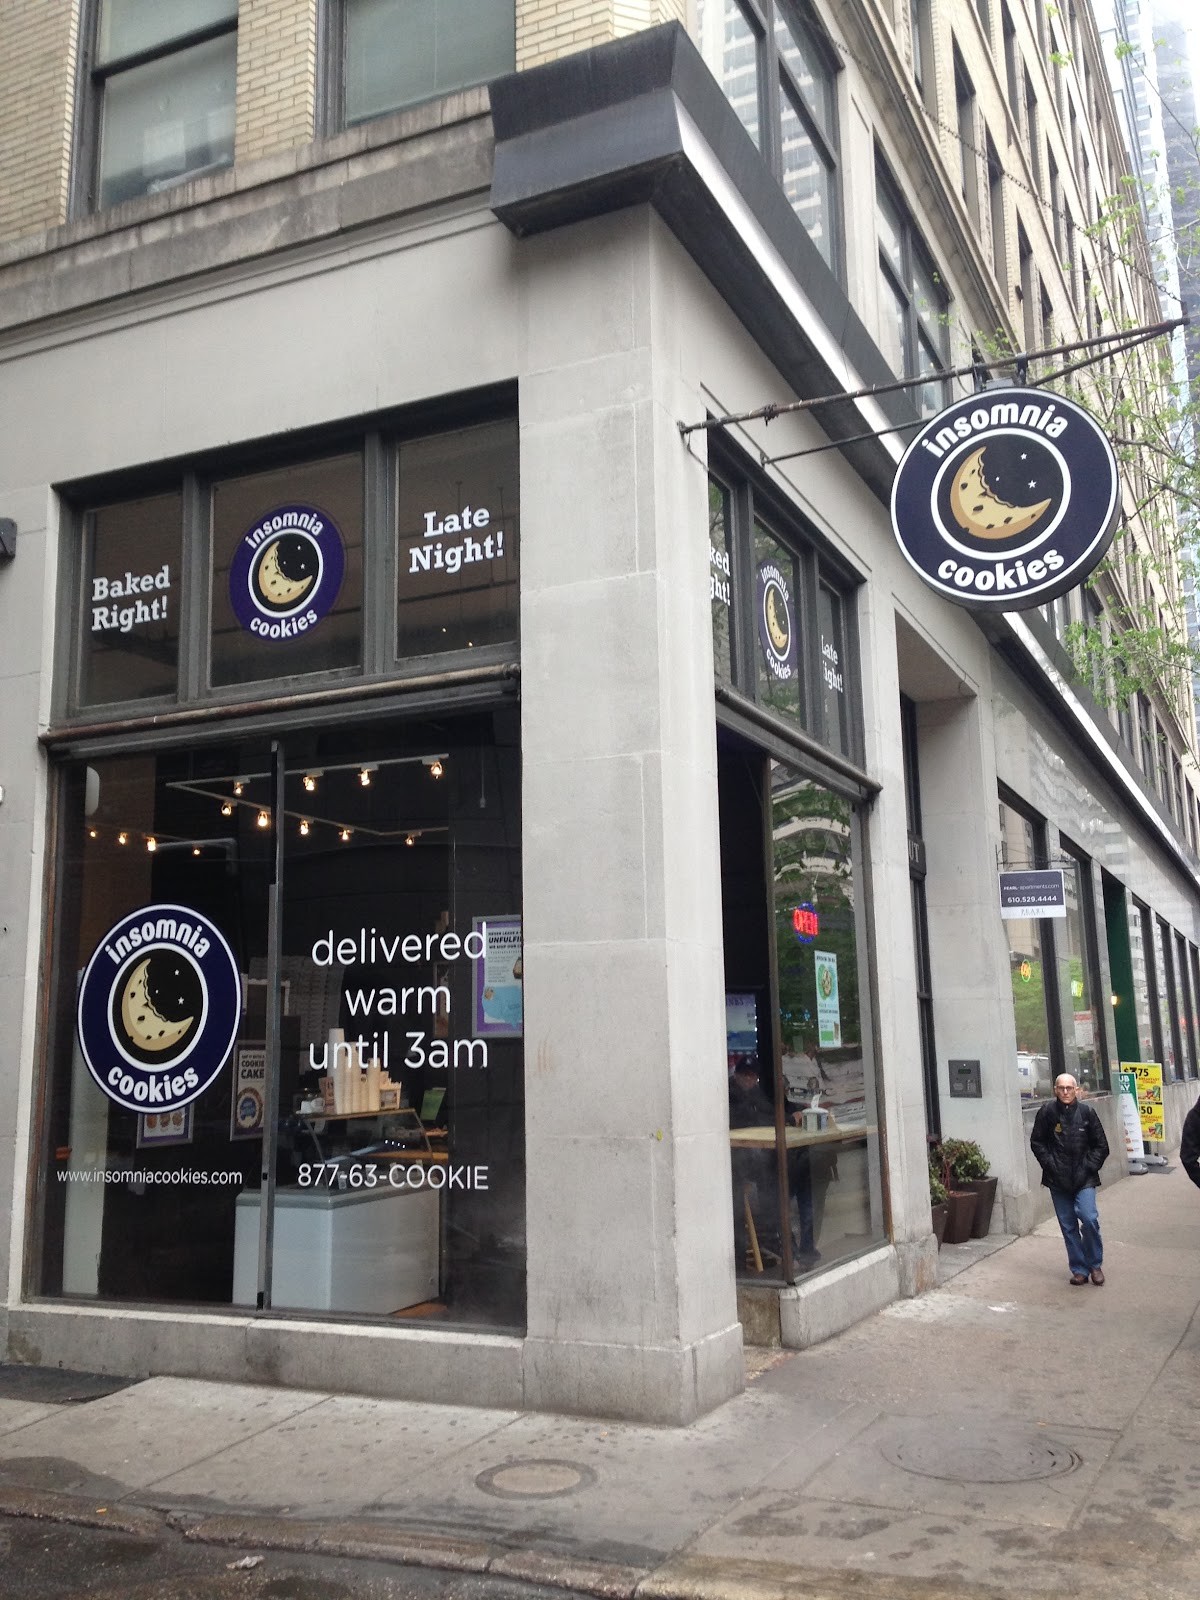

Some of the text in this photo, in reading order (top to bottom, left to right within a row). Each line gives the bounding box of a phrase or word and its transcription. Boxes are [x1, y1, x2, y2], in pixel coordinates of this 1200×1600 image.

[921, 402, 1068, 459] insomnia
[244, 511, 325, 550] insomnia
[423, 505, 490, 539] Late
[408, 531, 505, 574] Night!
[709, 538, 731, 577] ked
[91, 565, 170, 602] Baked
[760, 564, 789, 602] insomnia
[937, 549, 1065, 591] cookies
[710, 572, 731, 606] ght!
[91, 595, 169, 633] Right!
[250, 608, 318, 638] cookies
[766, 648, 792, 680] cookies
[820, 634, 839, 665] Late
[822, 660, 843, 693] ight!
[1007, 895, 1057, 903] 610.529.4444
[793, 909, 818, 936] OPEN
[104, 918, 211, 965] insomnia
[312, 921, 487, 967] delivered
[488, 936, 522, 944] UNFULFI
[345, 985, 451, 1017] warm
[309, 1031, 488, 1070] until 3am
[107, 1066, 200, 1103] cookies
[240, 1069, 265, 1079] CAKE
[56, 1166, 243, 1185] www.insomniacookies.com
[297, 1163, 489, 1190] 877-63-COOKIE
